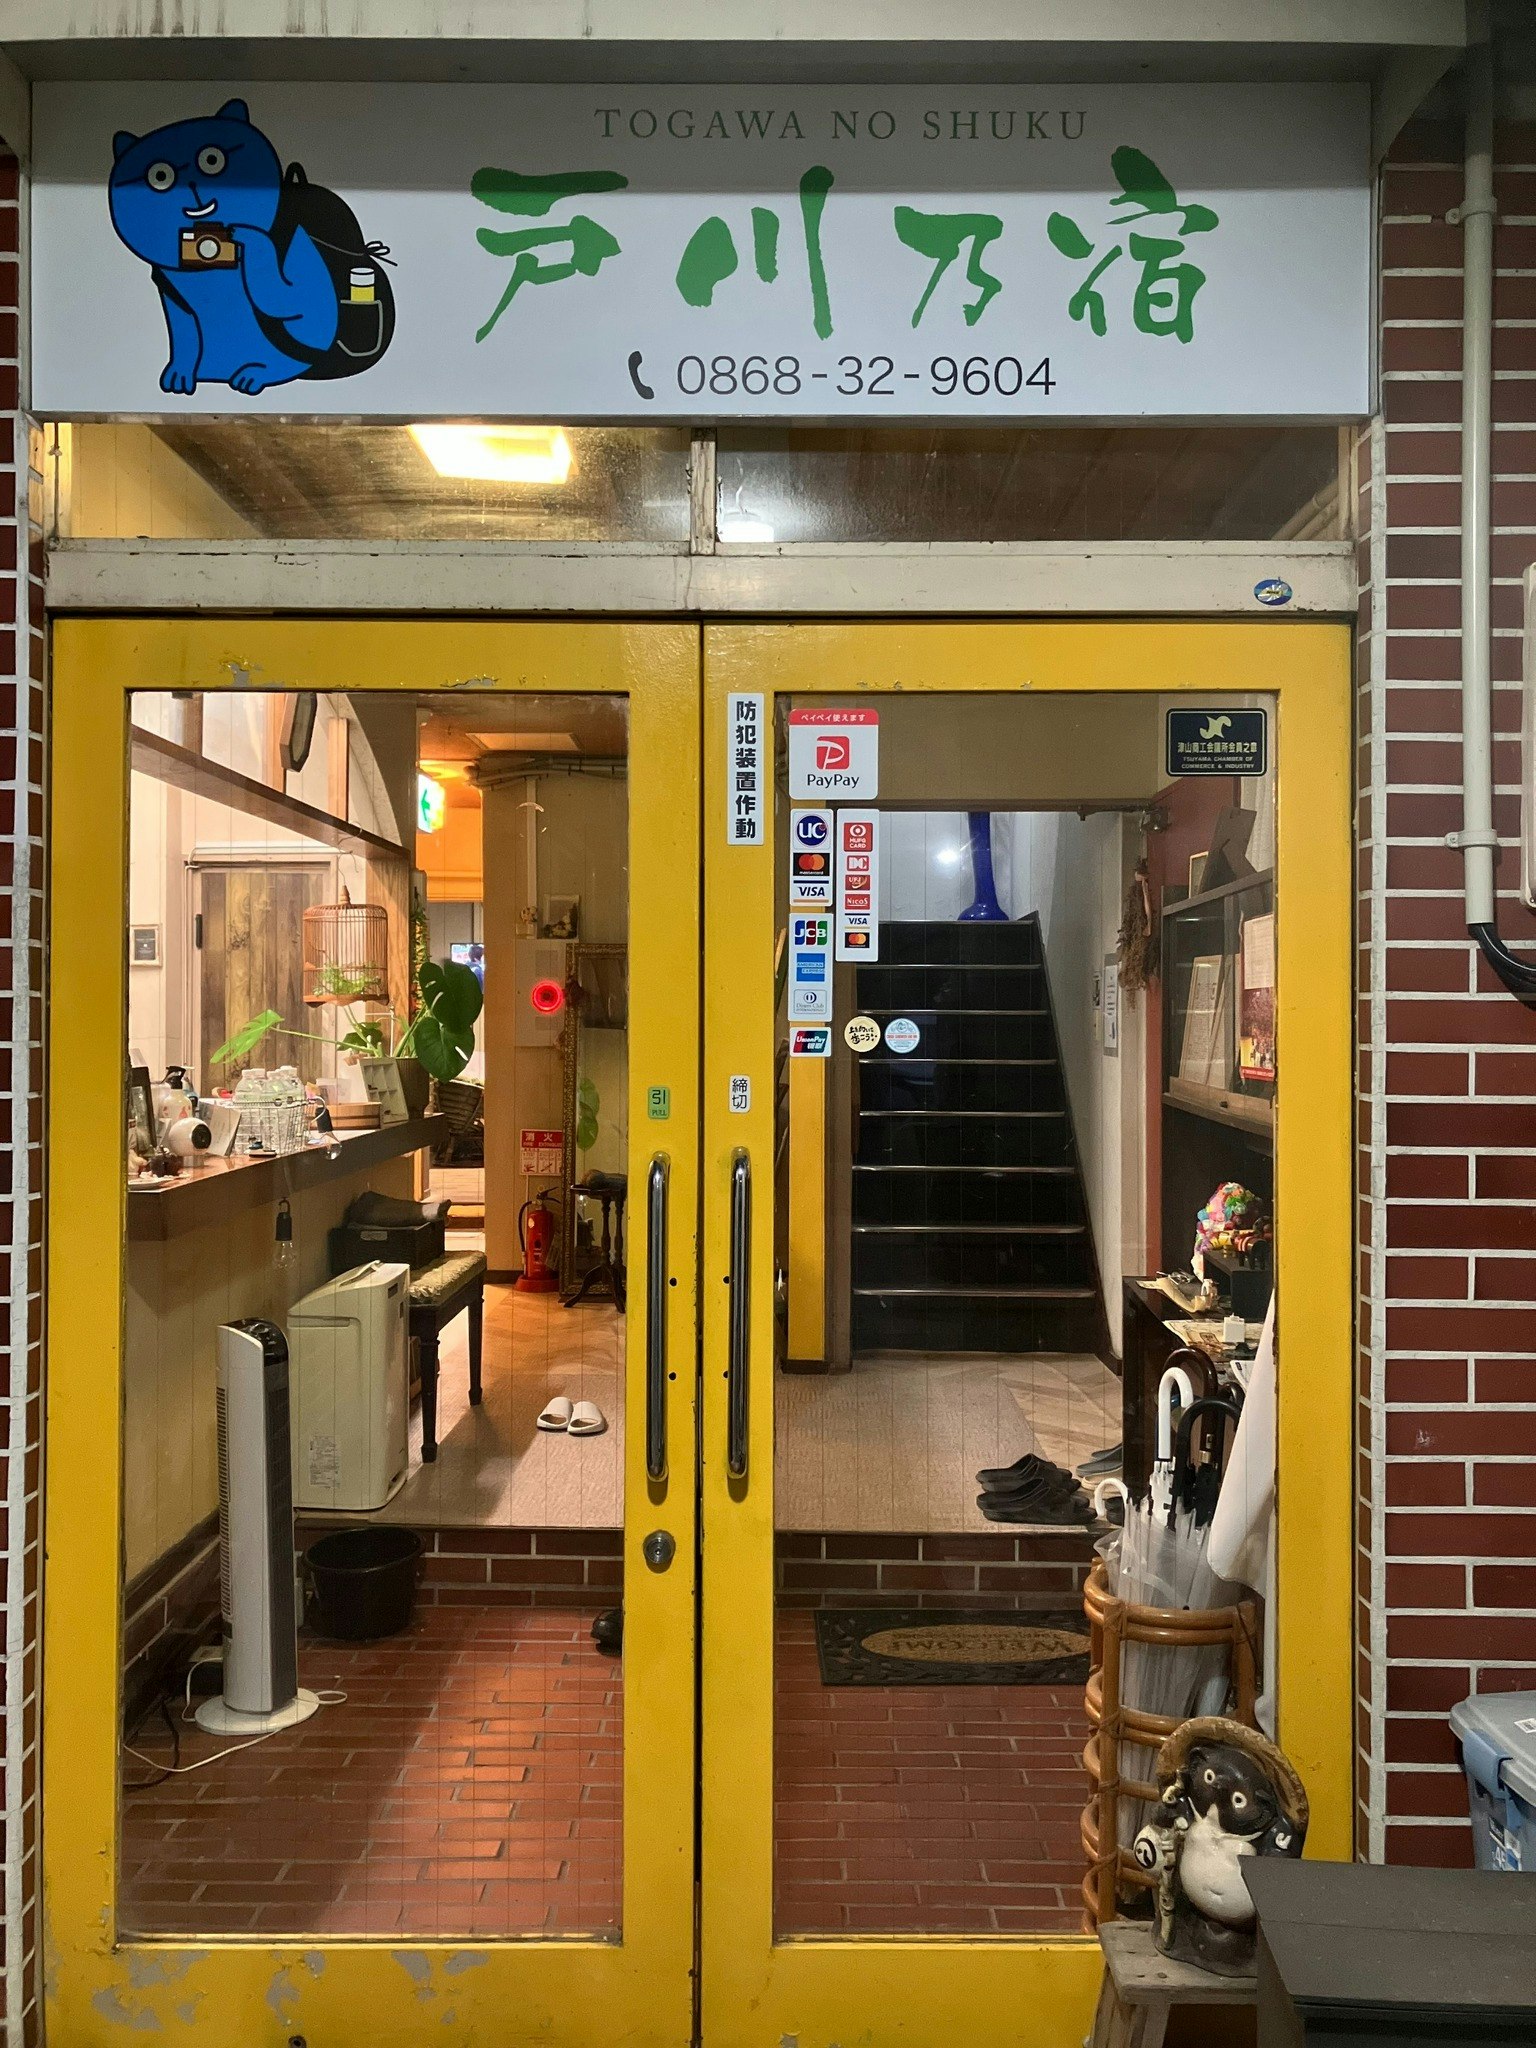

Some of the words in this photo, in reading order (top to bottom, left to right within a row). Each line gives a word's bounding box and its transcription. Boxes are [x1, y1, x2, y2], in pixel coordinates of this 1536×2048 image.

[593, 108, 806, 140] TOGAWA
[831, 109, 897, 141] NO
[922, 109, 1088, 141] SHUKU
[470, 145, 1219, 344] 戸川乃宿
[676, 355, 1057, 396] 0868-32-9604
[801, 713, 866, 722] ペイペイ使えます
[735, 700, 757, 839] 防犯装置作動
[807, 773, 860, 789] PayPay
[798, 886, 826, 897] VISA
[848, 917, 868, 925] VISA
[795, 928, 827, 938] JCB
[652, 1089, 666, 1105] 引
[731, 1078, 748, 1110] 締切
[524, 1132, 553, 1142] 消火
